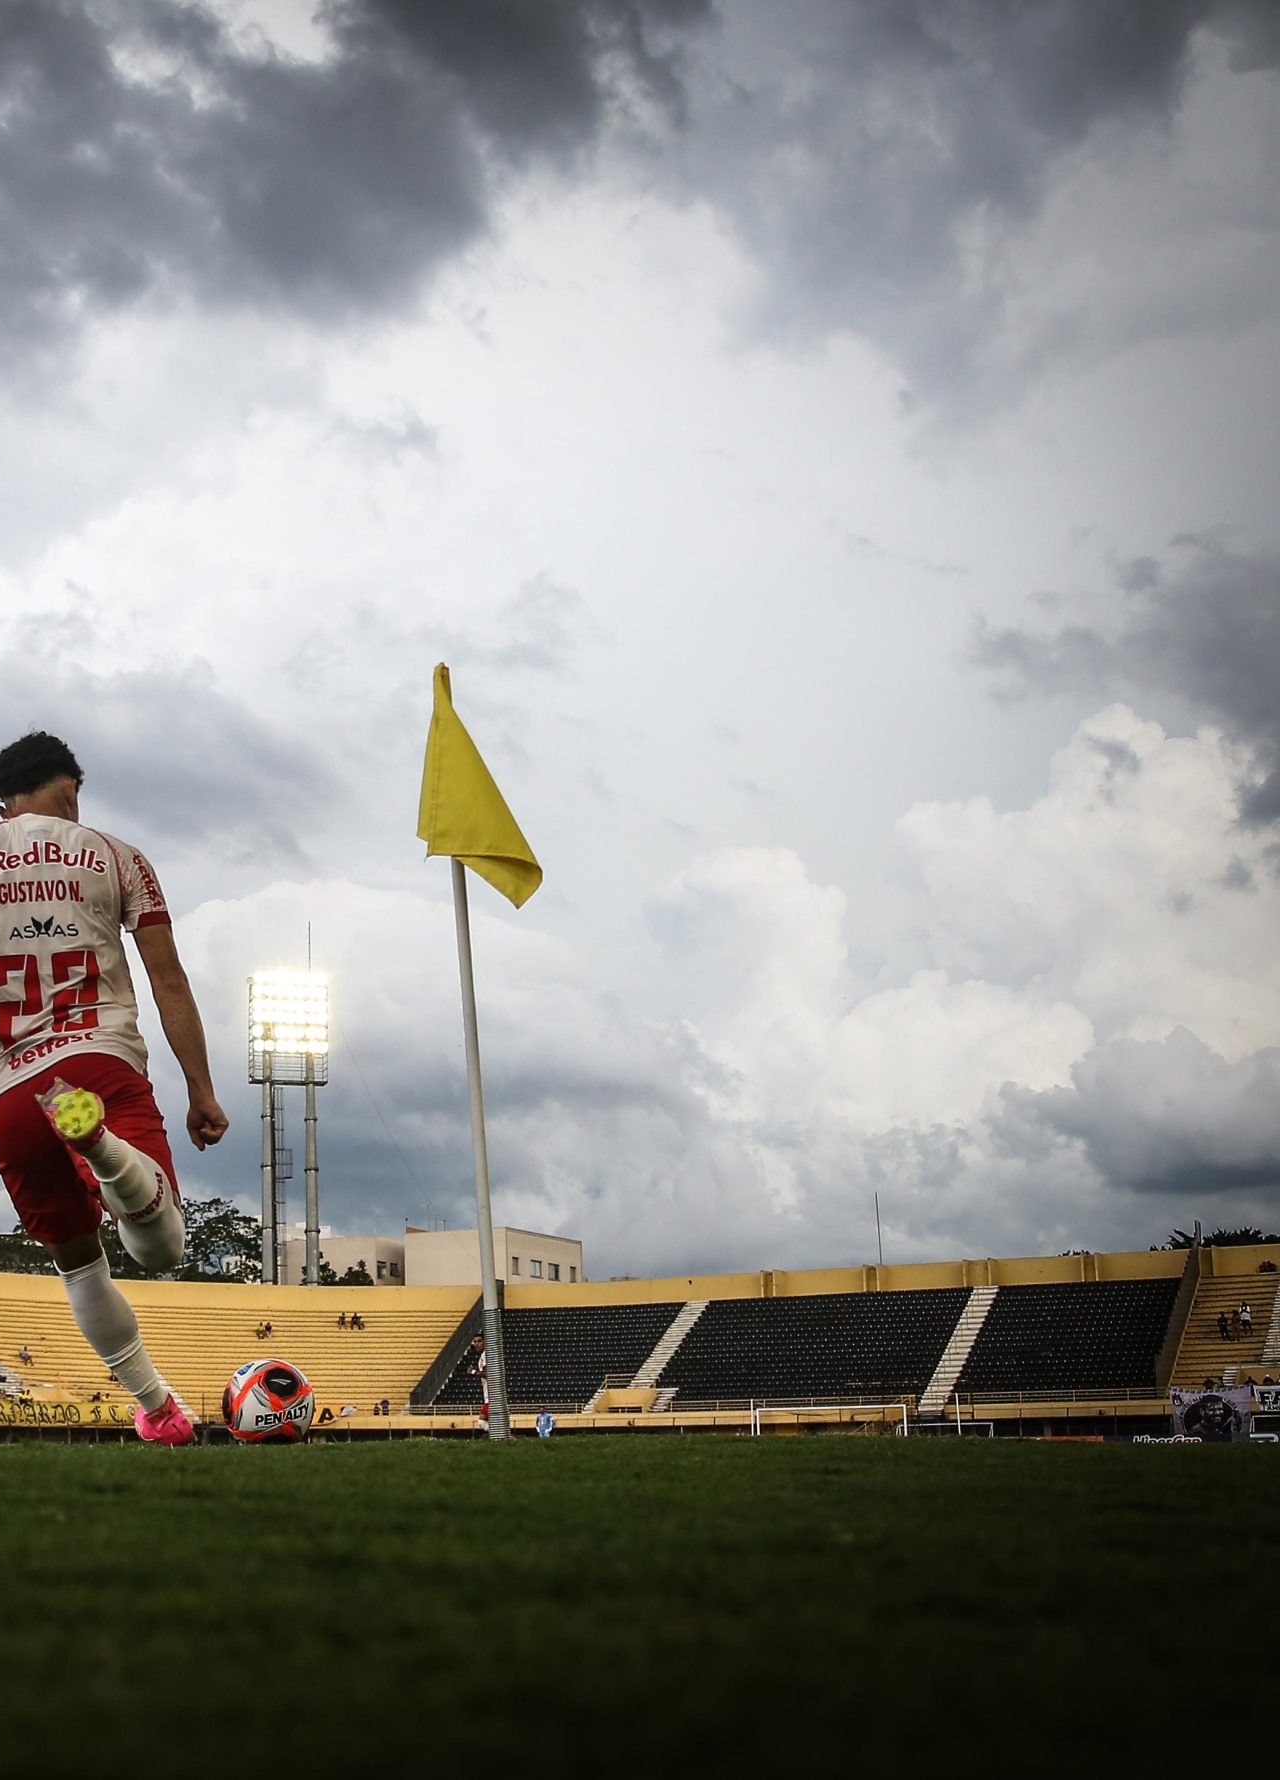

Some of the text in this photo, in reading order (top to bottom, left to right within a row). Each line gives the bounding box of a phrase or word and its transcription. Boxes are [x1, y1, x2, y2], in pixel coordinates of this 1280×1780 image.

[44, 841, 108, 873] Bulls
[68, 880, 85, 903] N.
[9, 916, 79, 941] ASAAS
[8, 1032, 94, 1070] betfast
[254, 1402, 310, 1427] PENALTY
